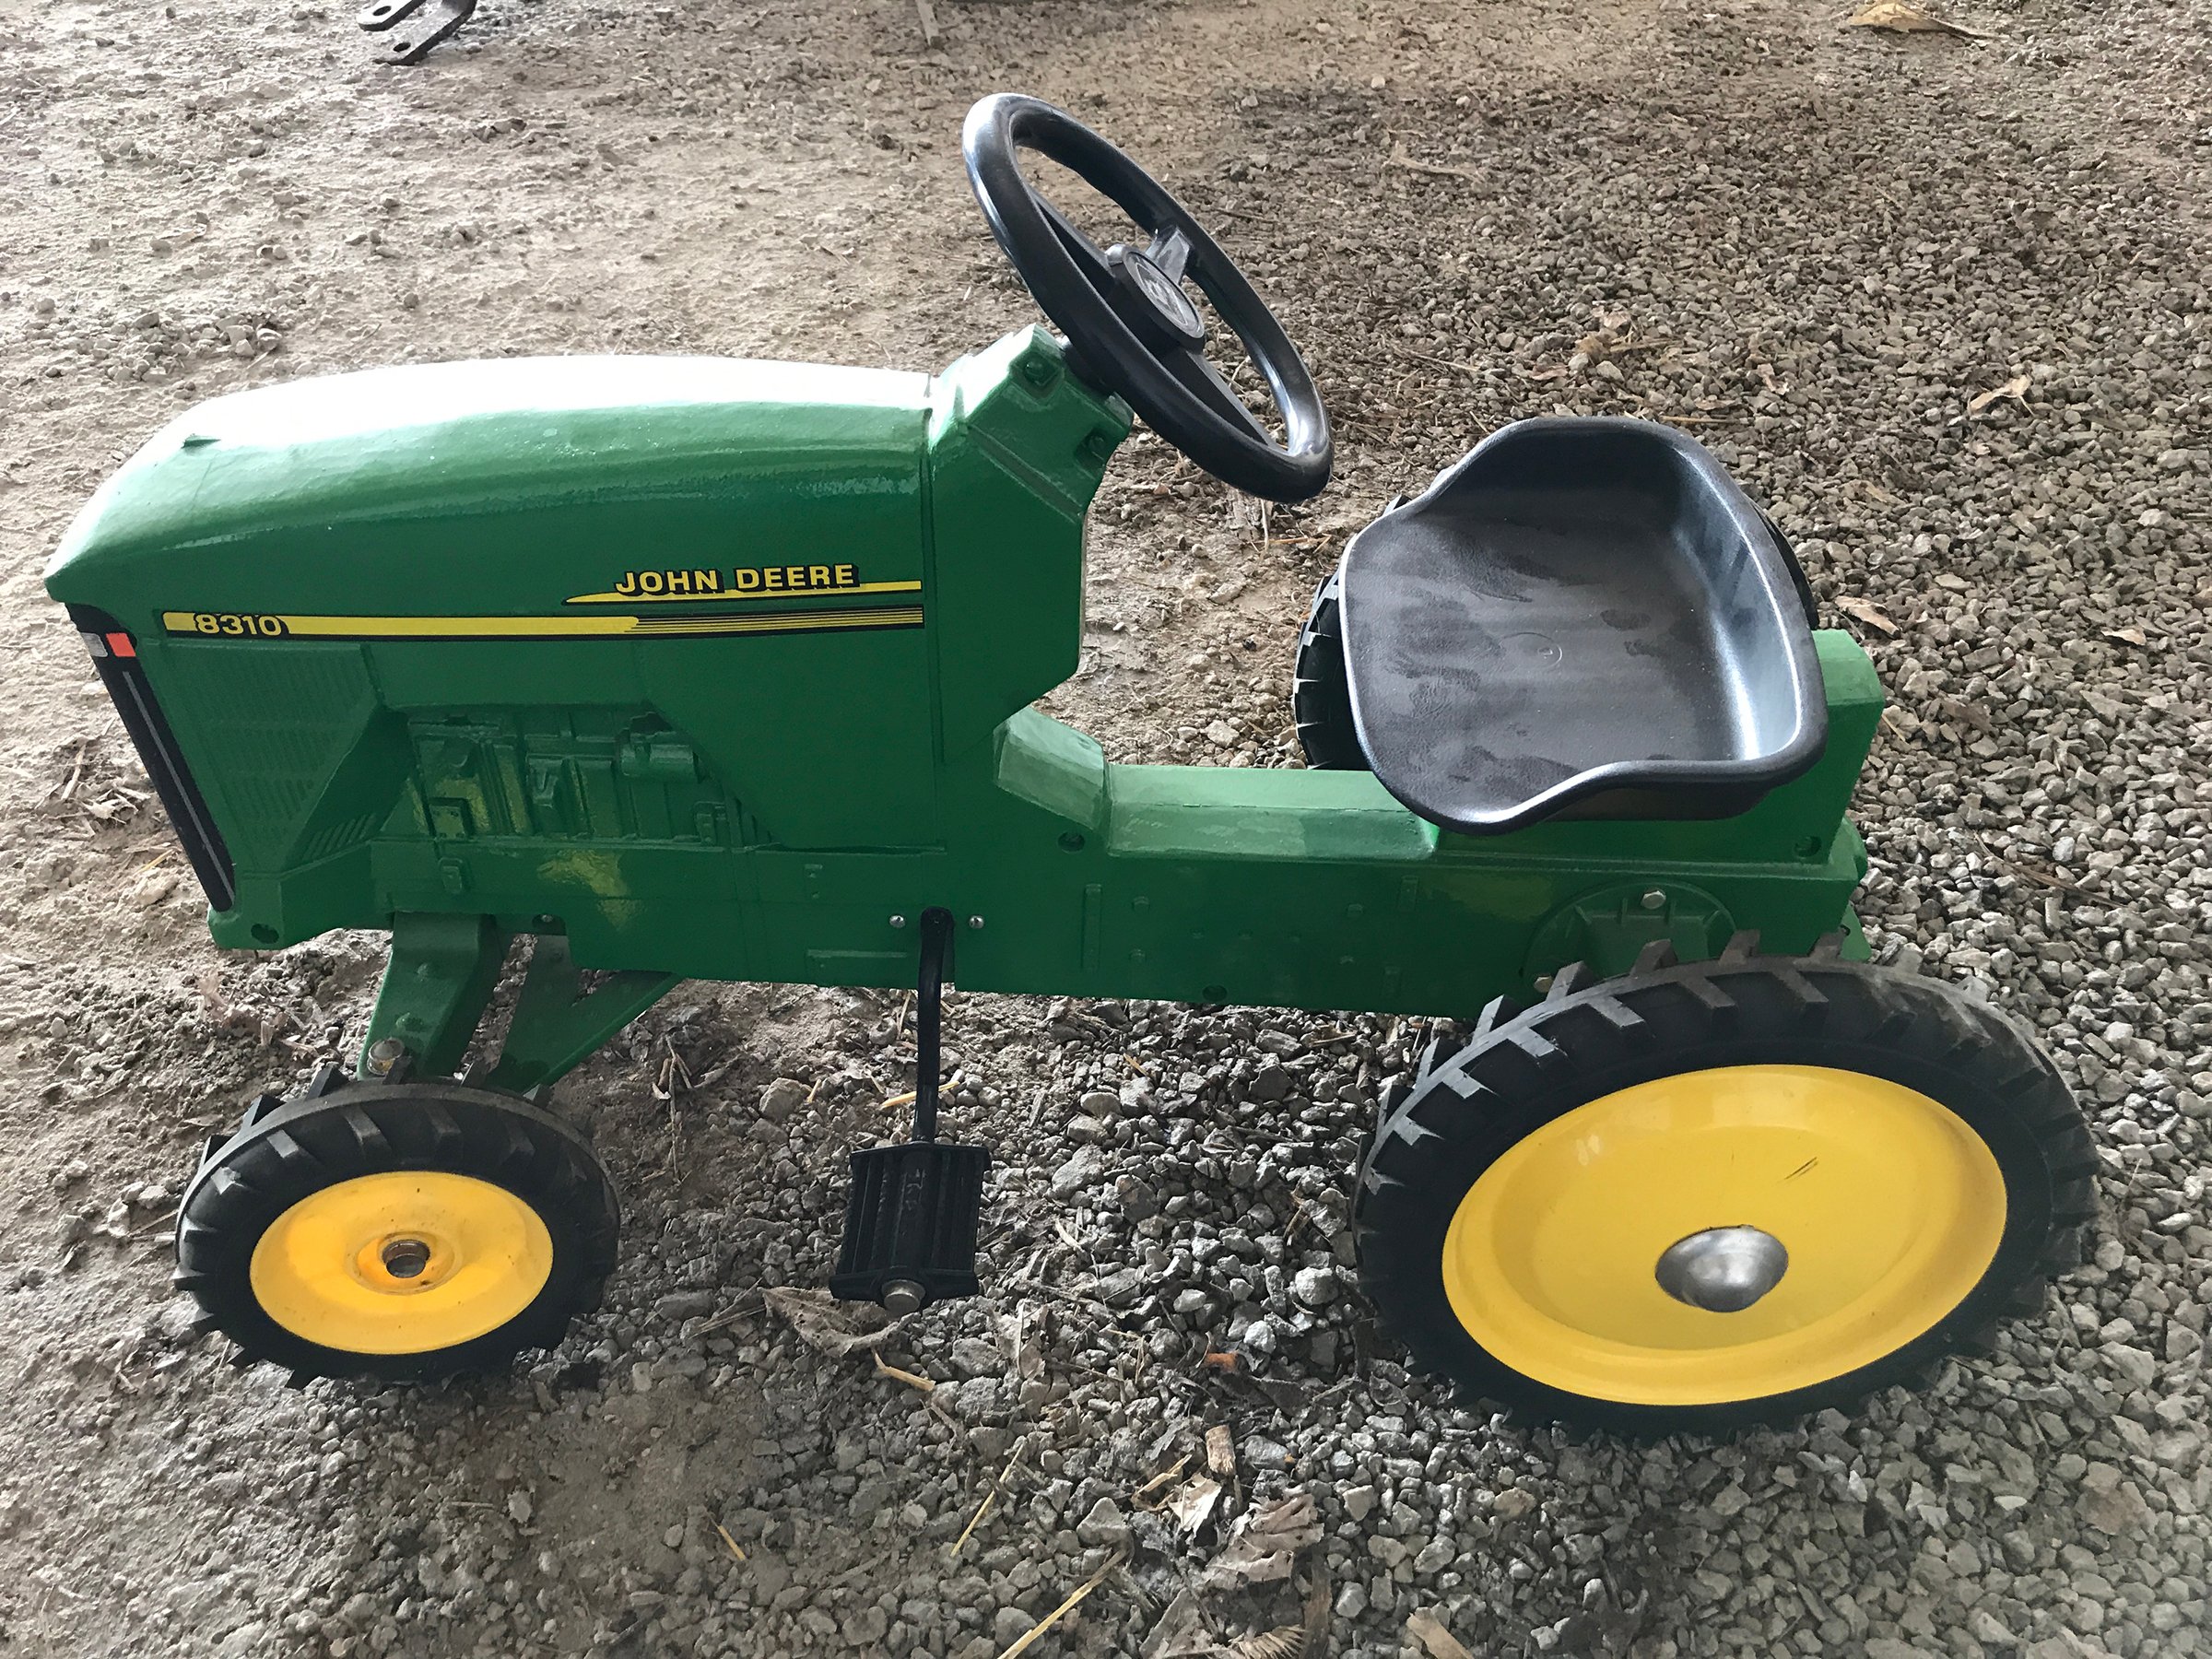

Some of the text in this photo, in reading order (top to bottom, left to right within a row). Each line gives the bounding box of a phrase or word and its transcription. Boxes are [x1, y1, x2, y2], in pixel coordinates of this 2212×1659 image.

[615, 563, 858, 595] JOHN DEERE
[194, 614, 283, 636] 8310
